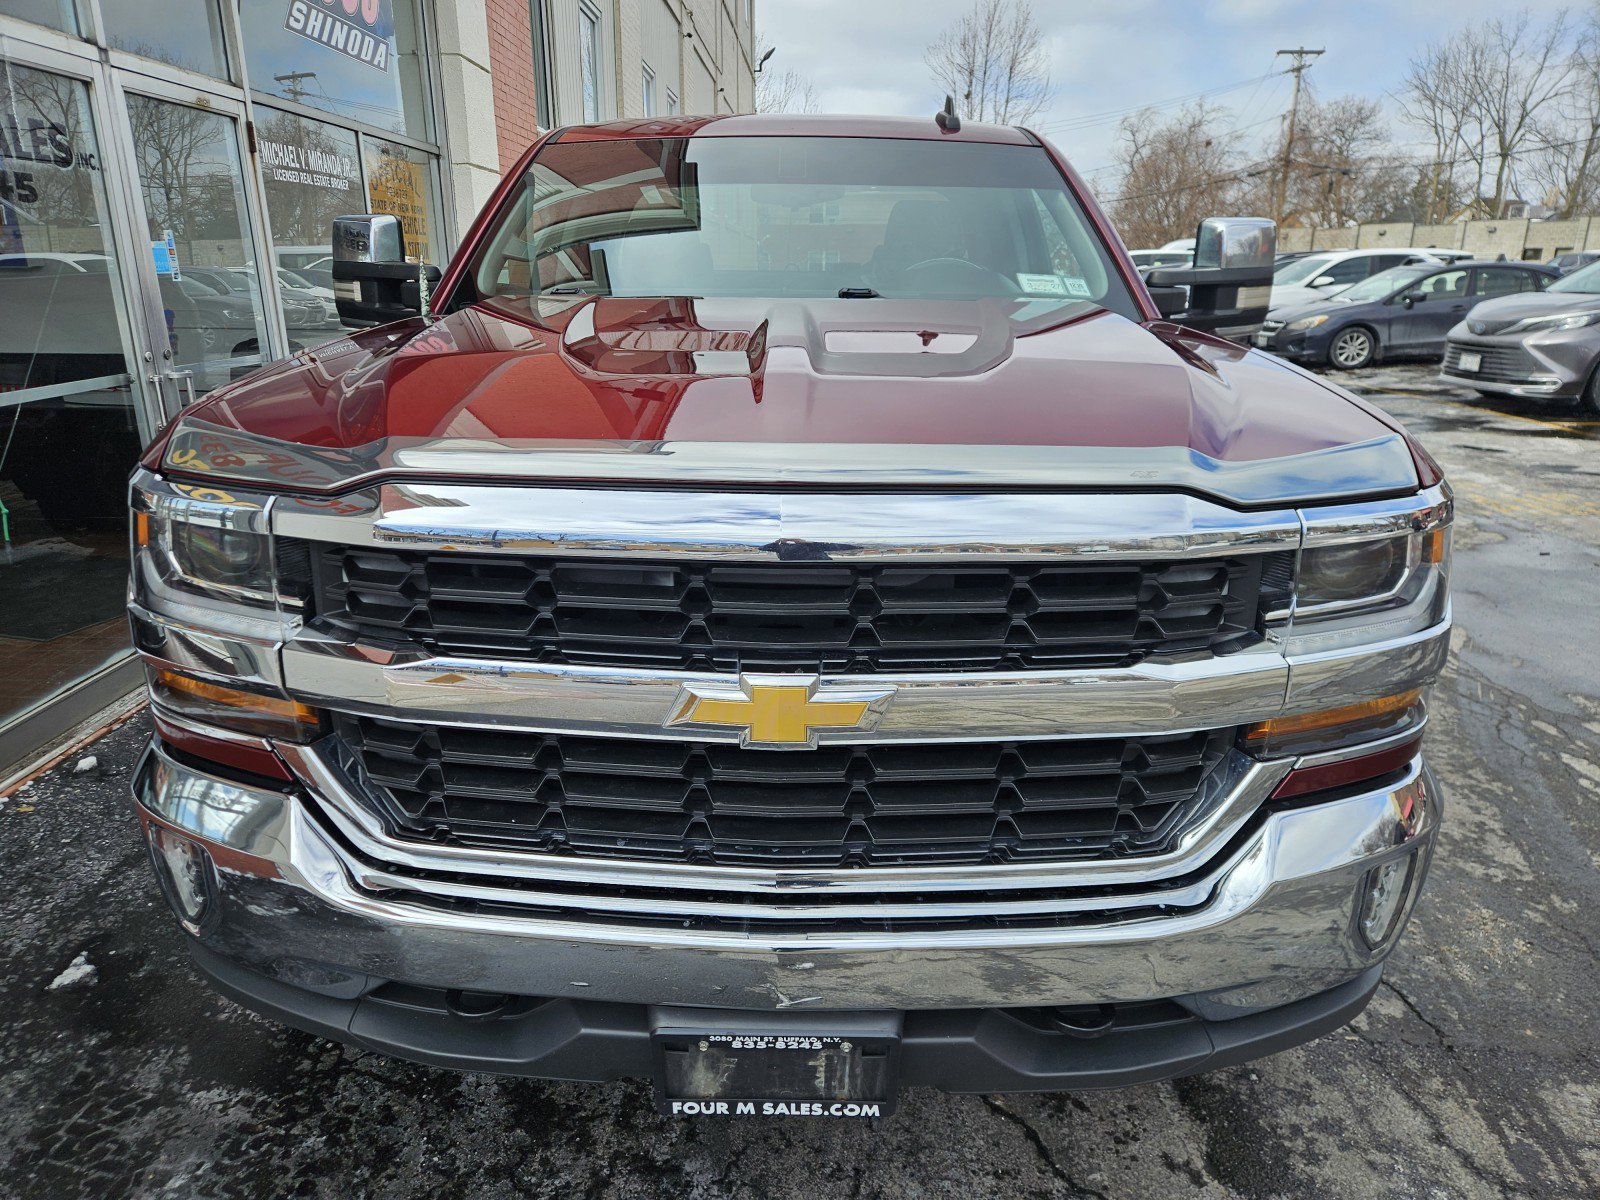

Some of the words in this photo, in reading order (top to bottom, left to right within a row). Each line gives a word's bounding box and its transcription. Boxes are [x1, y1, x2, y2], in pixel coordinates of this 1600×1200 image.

[288, 1, 387, 69] SHINODA
[260, 140, 300, 168] MICHAEL
[307, 149, 343, 176] MIRANDA
[273, 168, 300, 183] LICENSED
[300, 172, 314, 185] REAL
[313, 174, 331, 188] ESTATE
[371, 199, 387, 211] STATE
[731, 1041, 823, 1049] 835-8245
[672, 1101, 730, 1115] FOUR
[735, 1102, 756, 1115] M
[762, 1102, 880, 1117] SALES.COM
